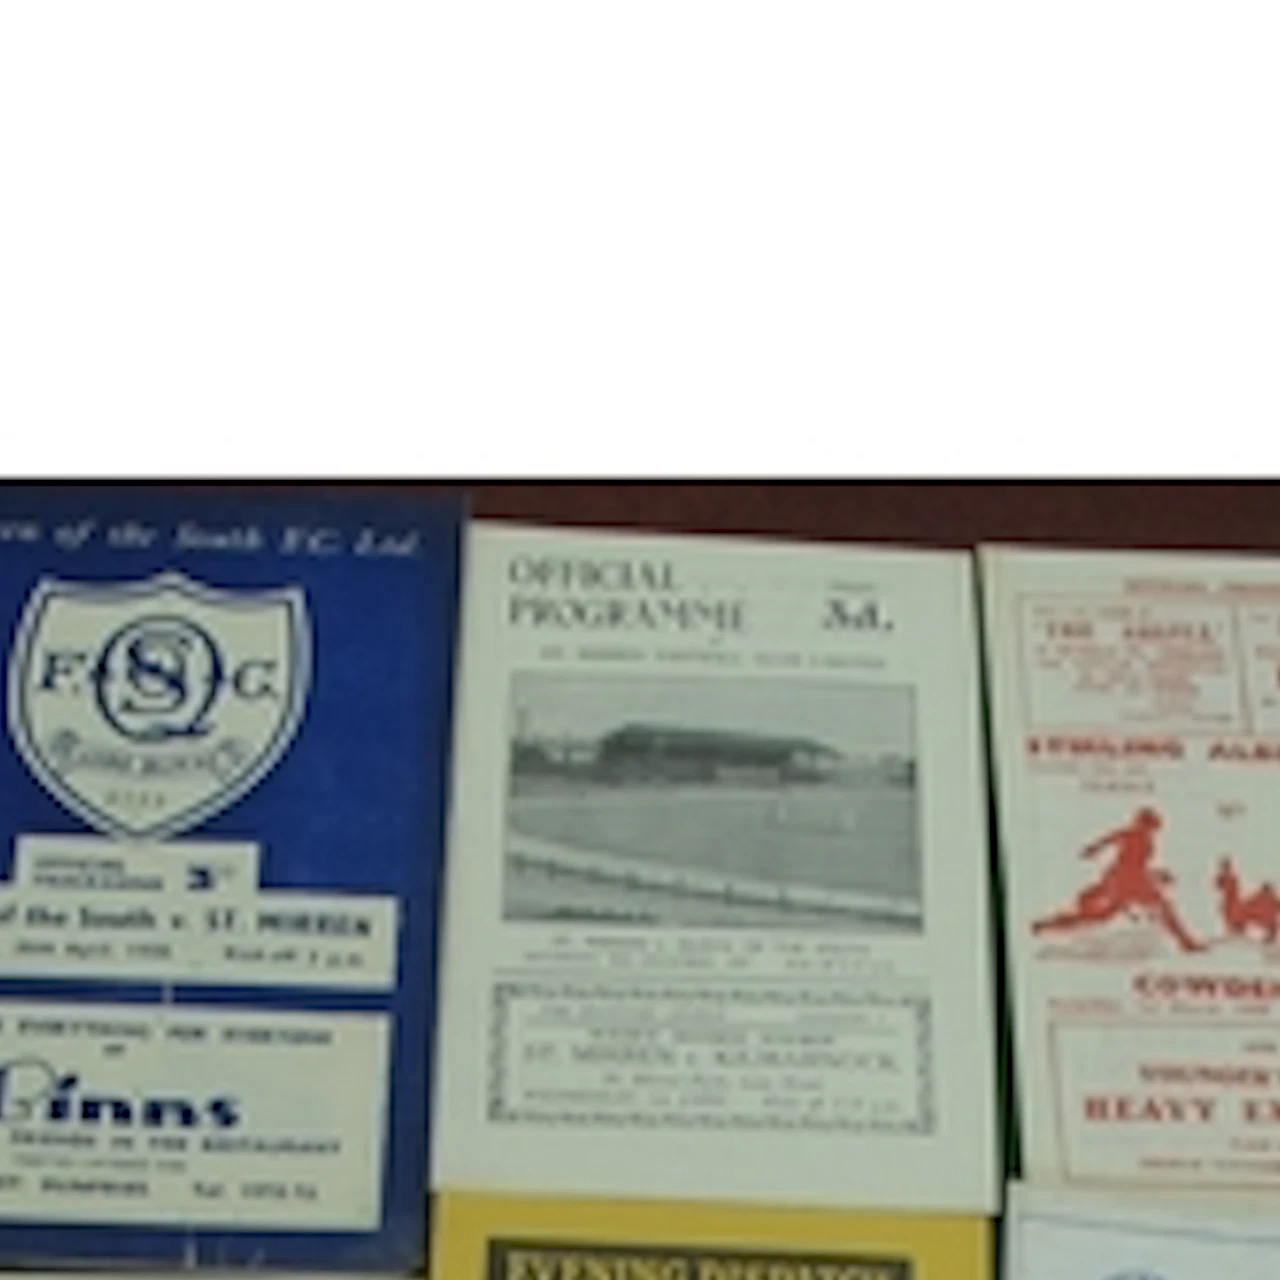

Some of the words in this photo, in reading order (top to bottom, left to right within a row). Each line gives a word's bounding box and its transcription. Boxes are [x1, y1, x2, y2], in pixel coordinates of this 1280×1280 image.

[171, 521, 265, 552] South
[508, 556, 682, 592] OFFICIAL
[508, 598, 746, 635] PROGRAMME
[25, 904, 67, 930] the
[79, 903, 156, 931] South
[1081, 1093, 1217, 1124] HEAVY
